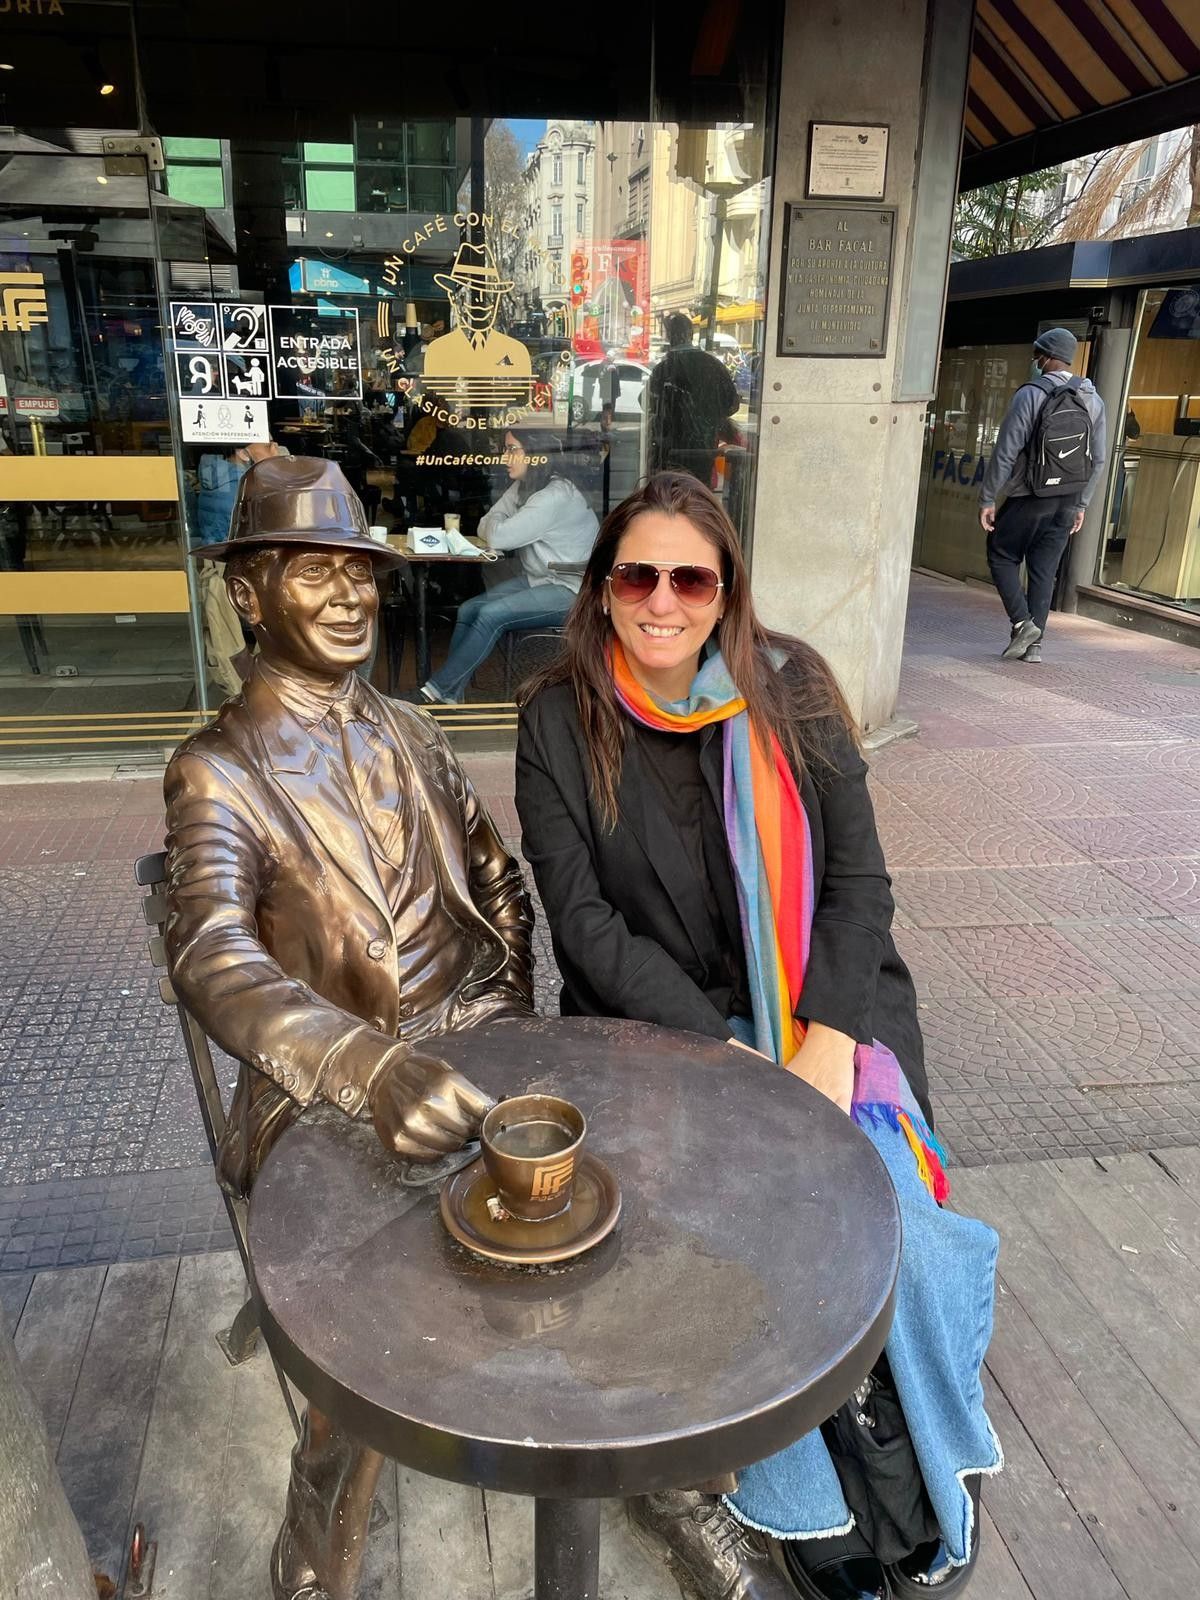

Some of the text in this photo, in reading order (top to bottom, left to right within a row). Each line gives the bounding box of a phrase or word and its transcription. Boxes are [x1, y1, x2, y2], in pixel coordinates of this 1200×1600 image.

[837, 221, 848, 231] AL
[382, 255, 404, 286] UN
[402, 214, 447, 254] CAFÉ
[453, 212, 495, 228] CON
[500, 221, 520, 239] EL
[809, 239, 874, 252] BAR FACAL
[280, 336, 352, 350] ENTRADA
[277, 356, 358, 370] ACCESIBLE
[381, 348, 400, 373] UN
[466, 417, 487, 430] DE
[18, 399, 56, 409] EMPUJE
[415, 453, 549, 467] #UnCaféConElMago
[933, 450, 985, 486] FACA
